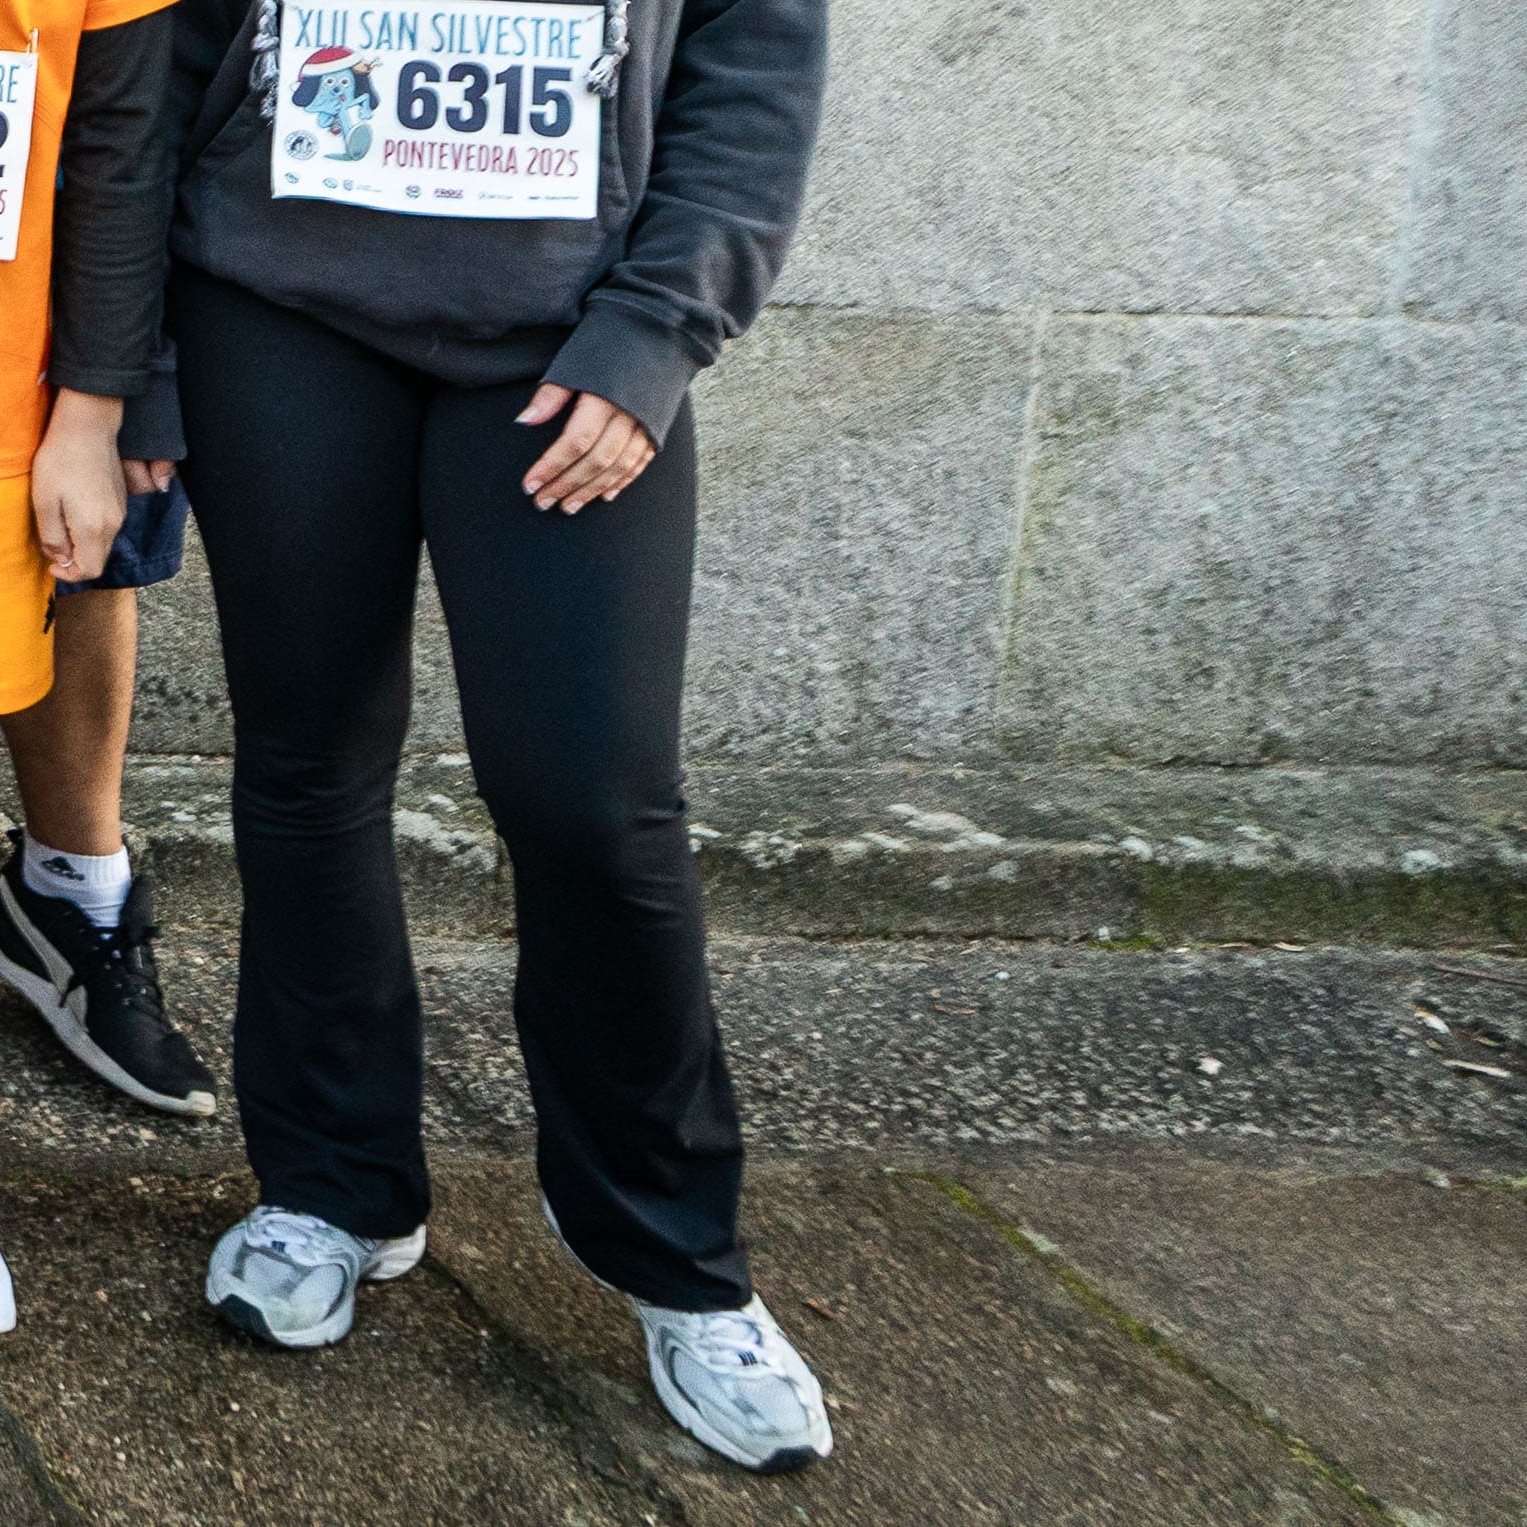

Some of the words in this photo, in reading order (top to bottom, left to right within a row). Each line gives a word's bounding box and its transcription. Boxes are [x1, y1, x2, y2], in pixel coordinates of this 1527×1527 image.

[295, 9, 347, 47] XLII
[360, 11, 417, 51] SAN
[431, 13, 582, 59] SILVESTRE
[397, 59, 573, 137] 6315
[382, 140, 518, 175] PONTEVEDRA
[527, 148, 578, 177] 2025
